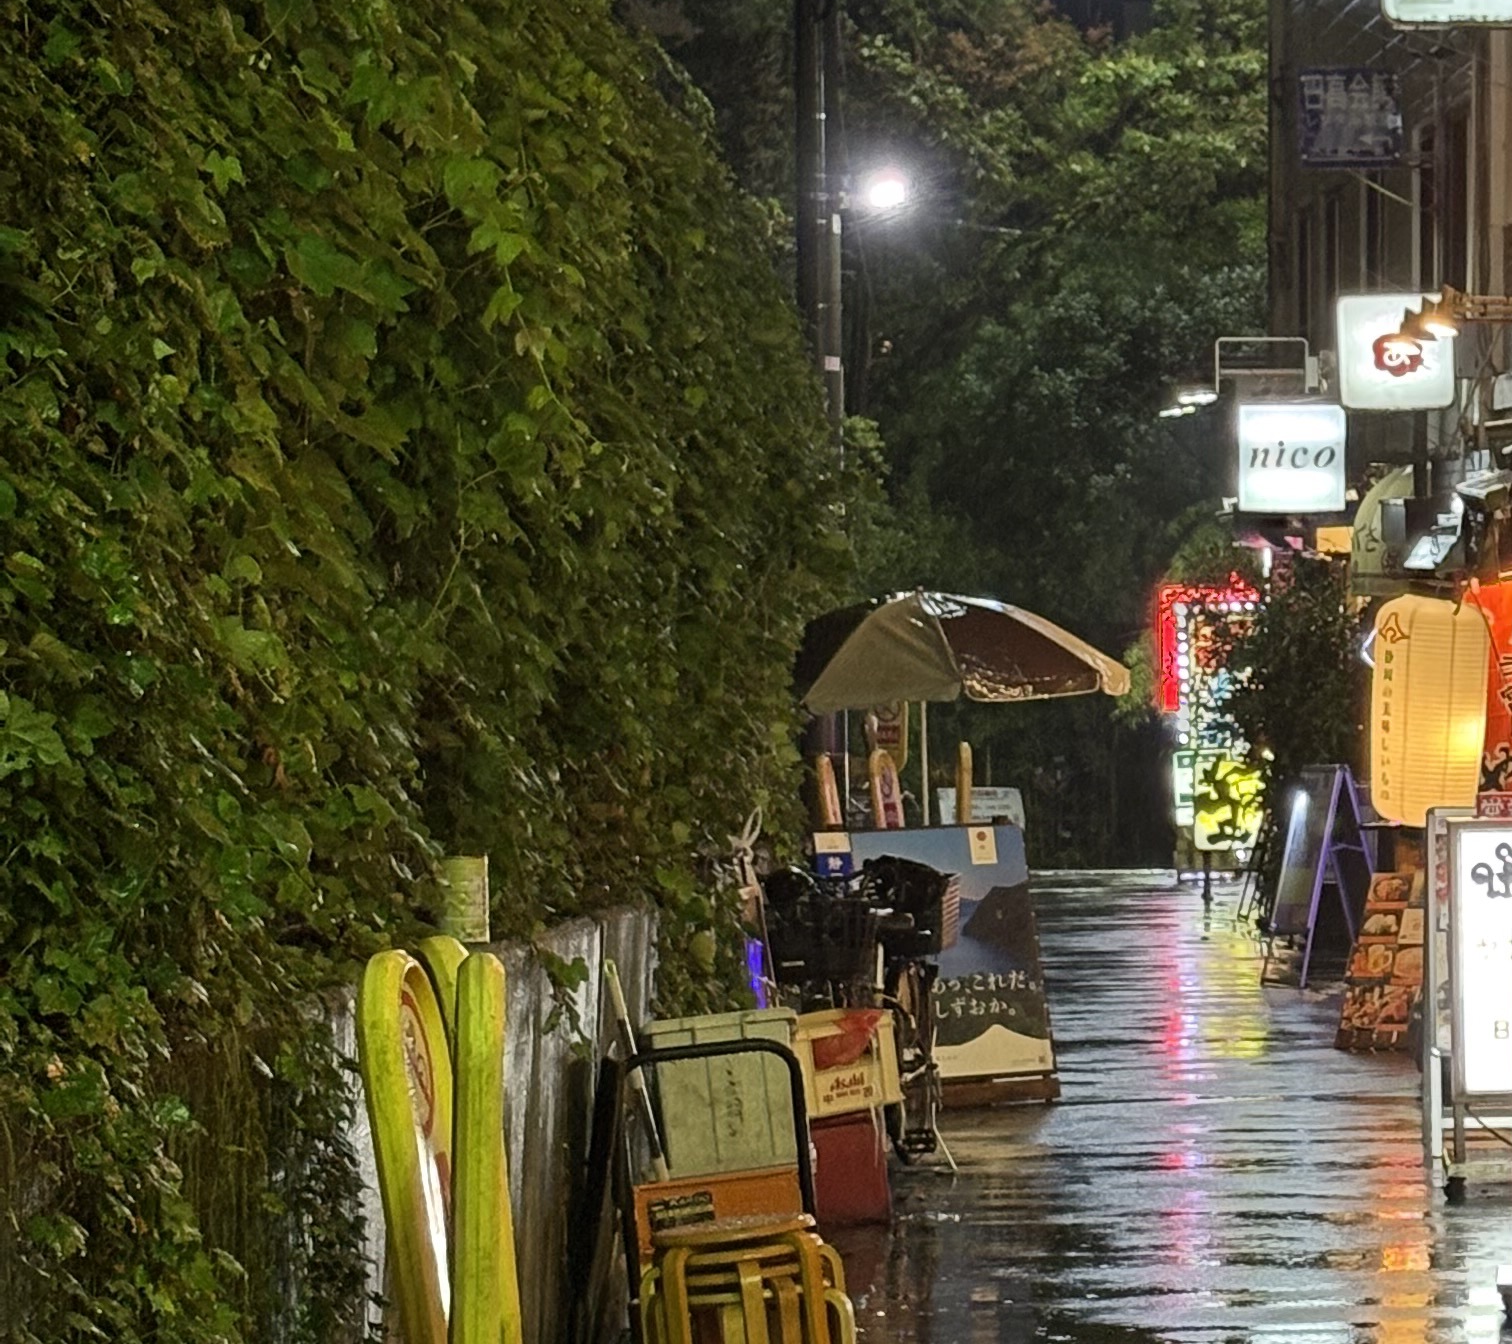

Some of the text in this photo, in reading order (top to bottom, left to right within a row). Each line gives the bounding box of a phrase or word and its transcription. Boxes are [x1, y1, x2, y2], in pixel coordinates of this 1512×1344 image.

[1249, 440, 1336, 470] nico
[935, 996, 1017, 1019] しずおか。
